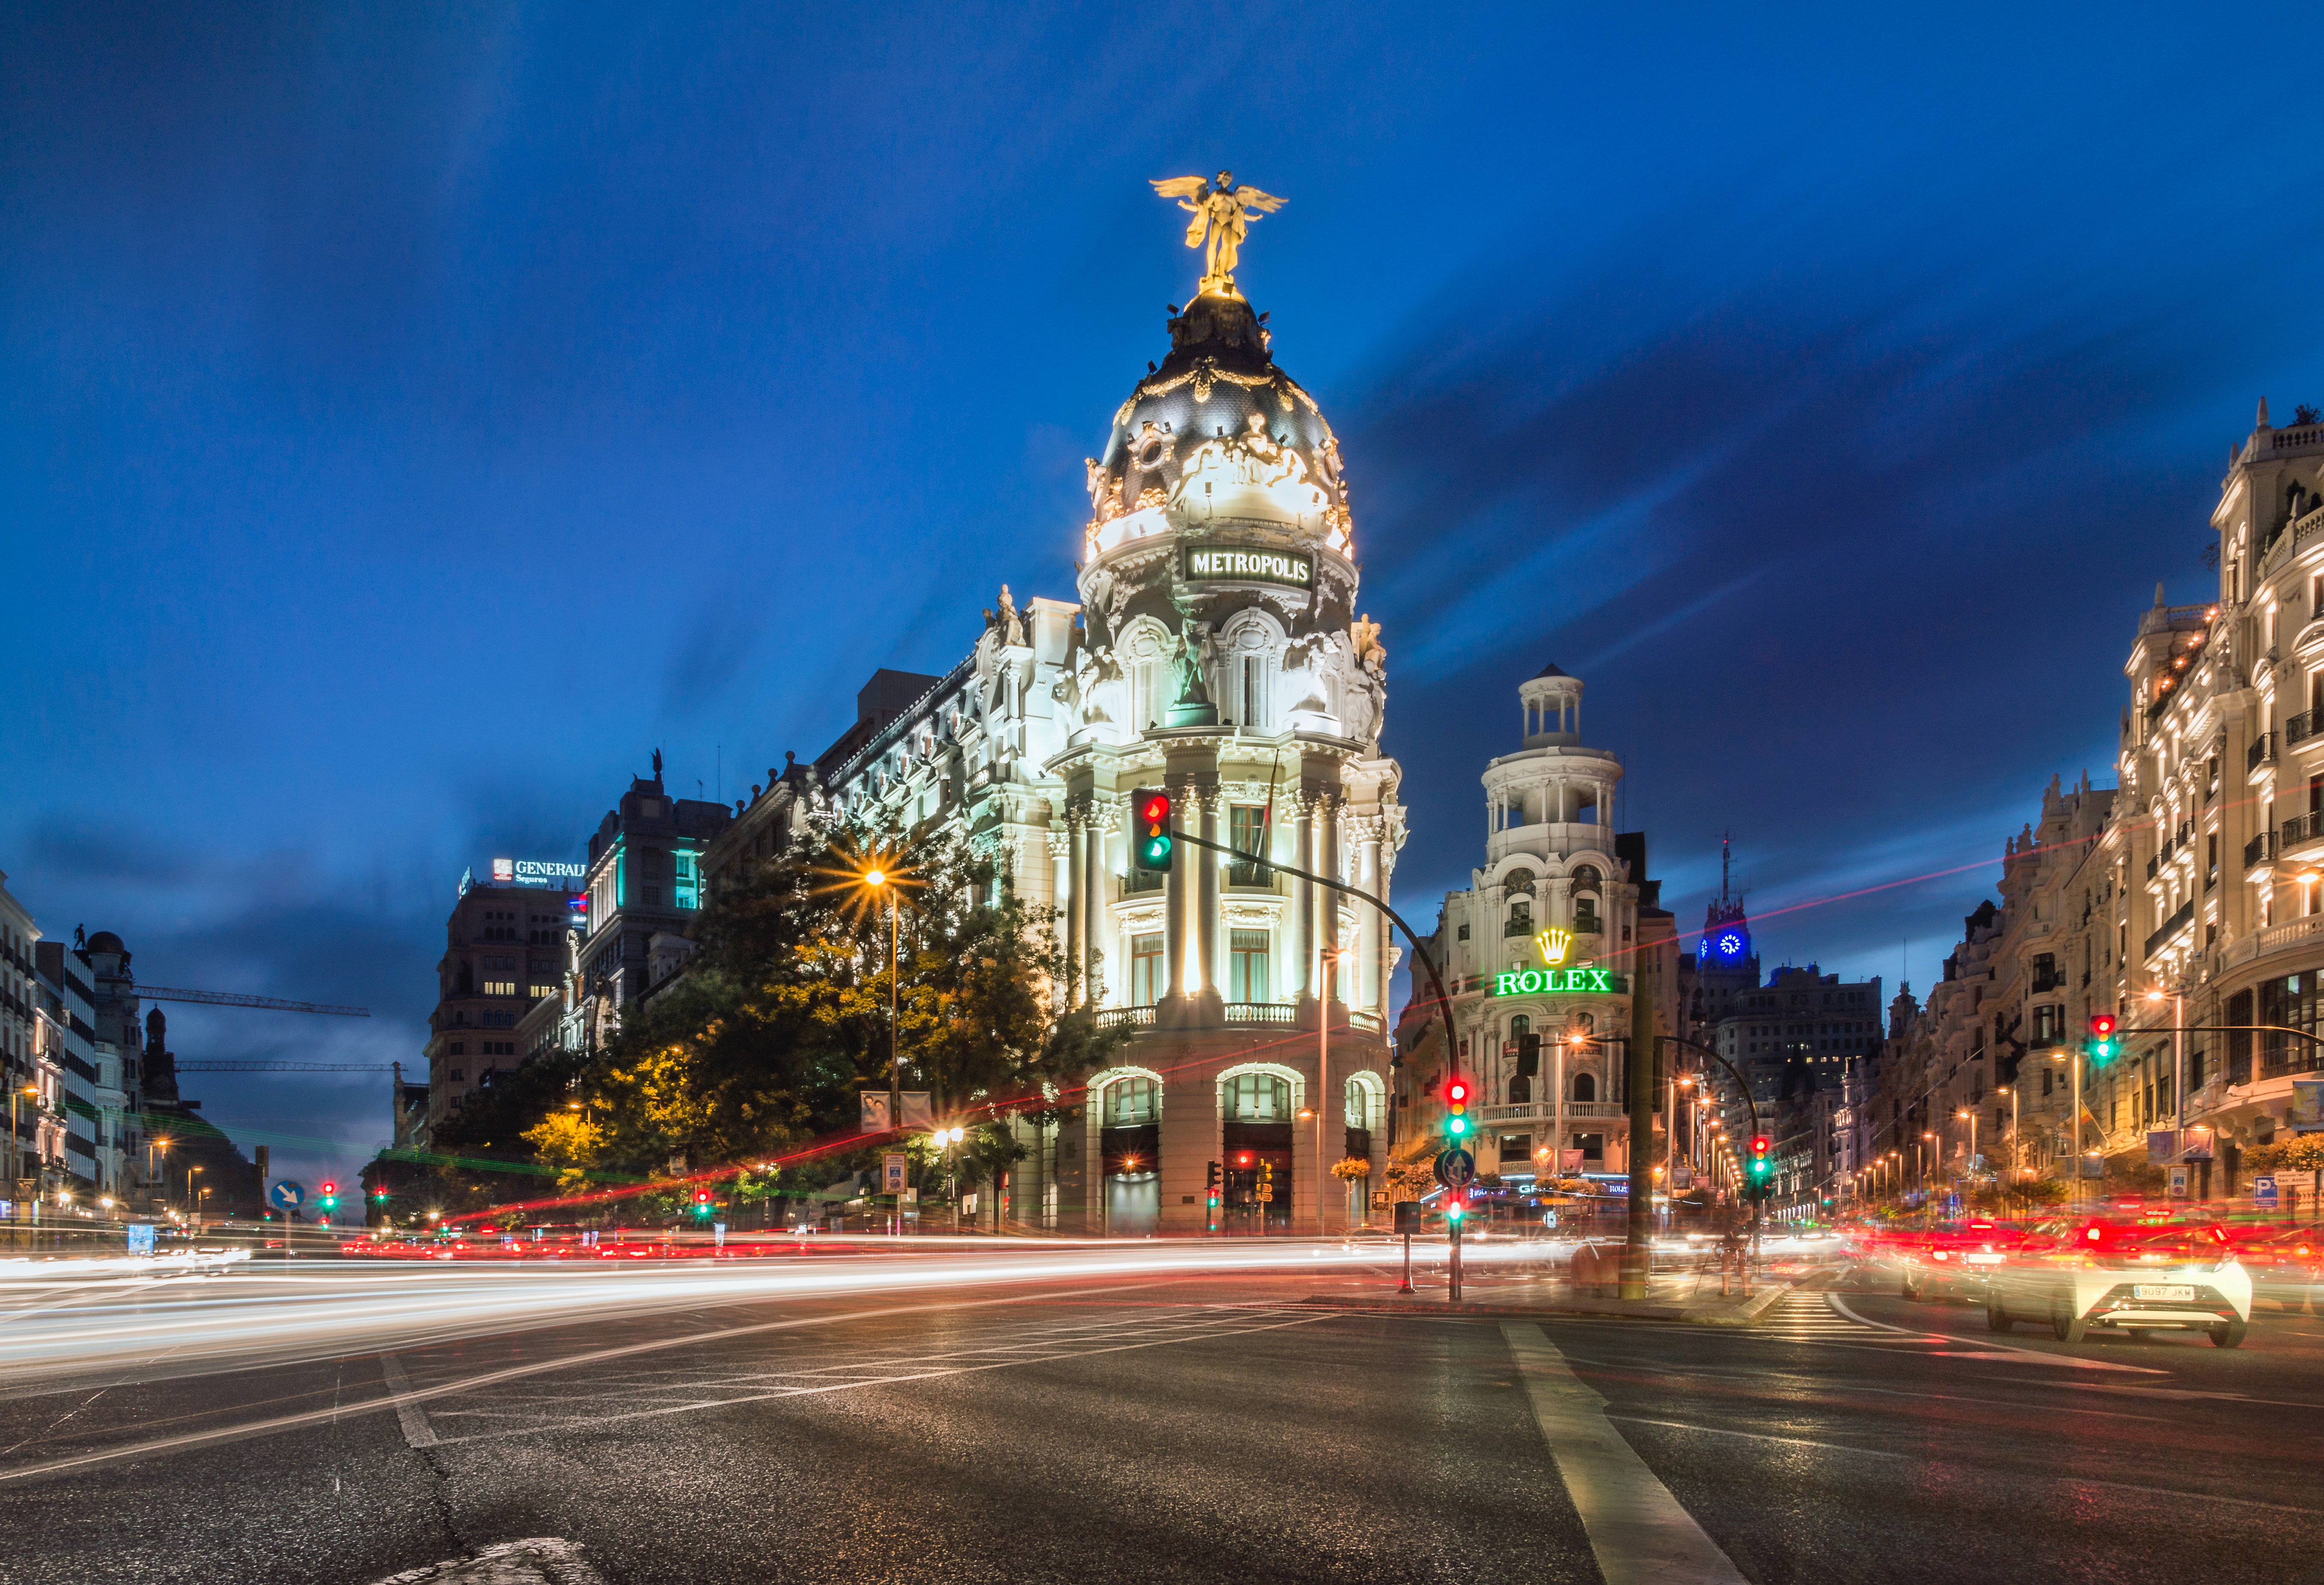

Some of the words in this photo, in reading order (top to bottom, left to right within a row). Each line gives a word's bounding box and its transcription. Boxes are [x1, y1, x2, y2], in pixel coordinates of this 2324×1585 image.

[1194, 552, 1309, 581] METROPOLIS
[515, 874, 548, 884] Seguros
[1496, 969, 1611, 996] ROLEX
[2257, 1179, 2271, 1196] P
[2141, 1287, 2167, 1296] 9097
[2172, 1288, 2190, 1296] JKM
